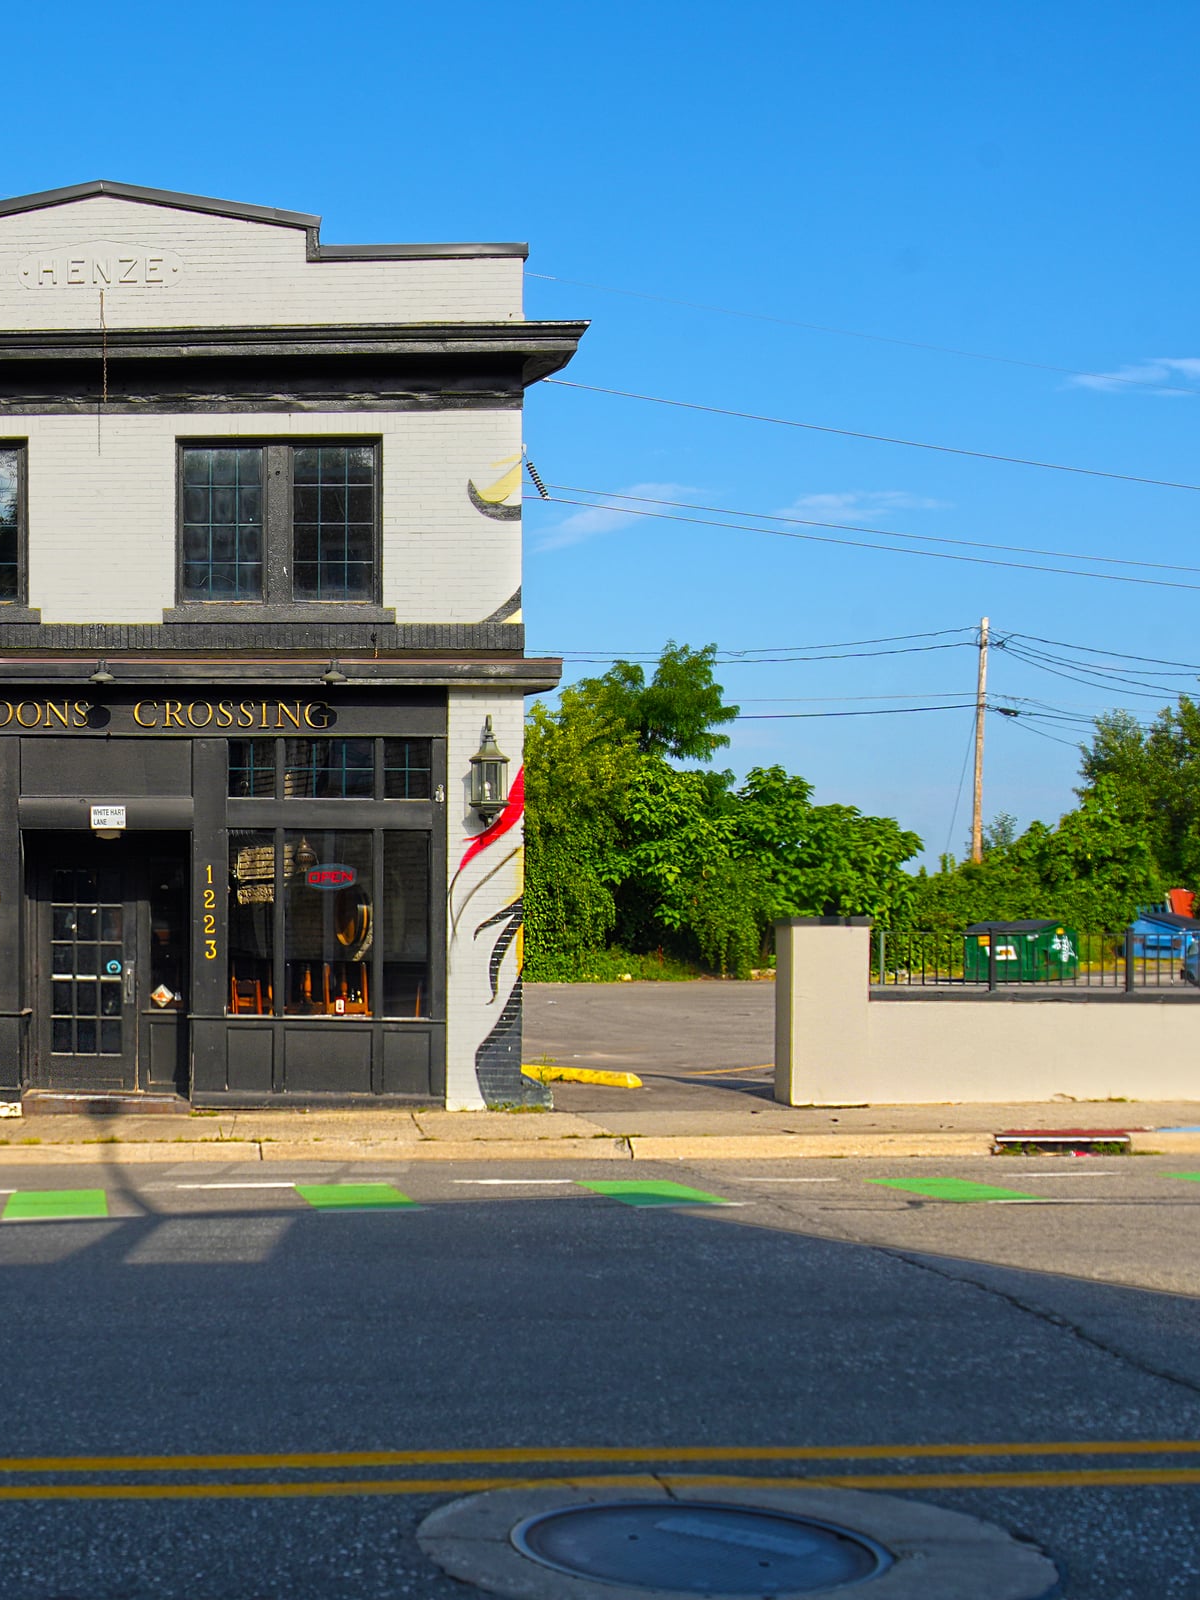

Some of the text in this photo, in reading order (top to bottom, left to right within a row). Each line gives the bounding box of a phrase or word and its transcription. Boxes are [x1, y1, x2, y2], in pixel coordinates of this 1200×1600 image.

[38, 256, 164, 285] HENZE
[133, 699, 329, 728] CROSSING
[93, 808, 124, 816] WHITE HART
[308, 871, 353, 883] OPEN
[203, 864, 217, 960] 1223
